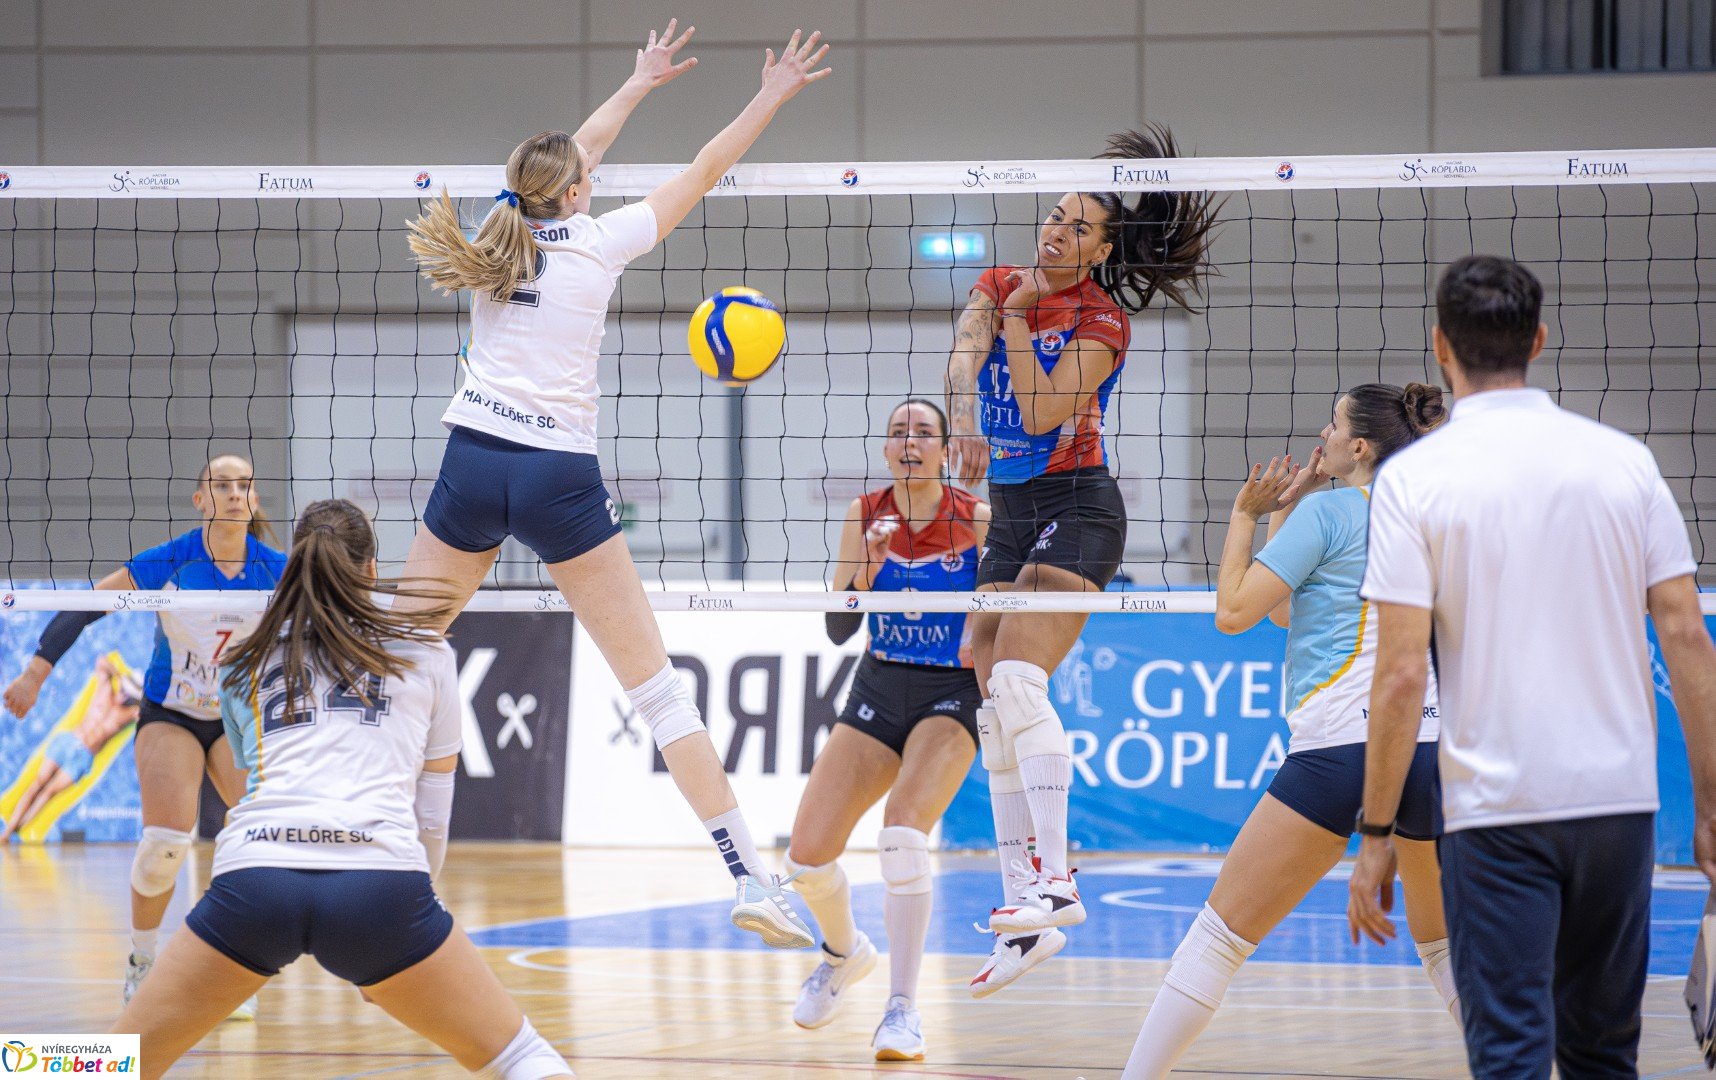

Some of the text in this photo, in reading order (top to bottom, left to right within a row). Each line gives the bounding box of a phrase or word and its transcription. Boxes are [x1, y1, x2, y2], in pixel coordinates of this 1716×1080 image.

[1112, 165, 1170, 182] FATUM
[1431, 164, 1477, 174] RÖPLABDA
[1567, 158, 1629, 174] FATUM
[138, 177, 181, 187] RÖPLABDA
[258, 172, 314, 190] FATUM
[993, 172, 1037, 181] RÖPLABDA
[536, 415, 556, 429] SC
[688, 594, 733, 609] FATUM
[1120, 595, 1167, 610] FATUM
[876, 613, 950, 644] FATUM
[210, 629, 233, 665] 7
[1132, 659, 1285, 719] GYE
[258, 660, 392, 738] 24
[285, 826, 345, 843] ELŐRE
